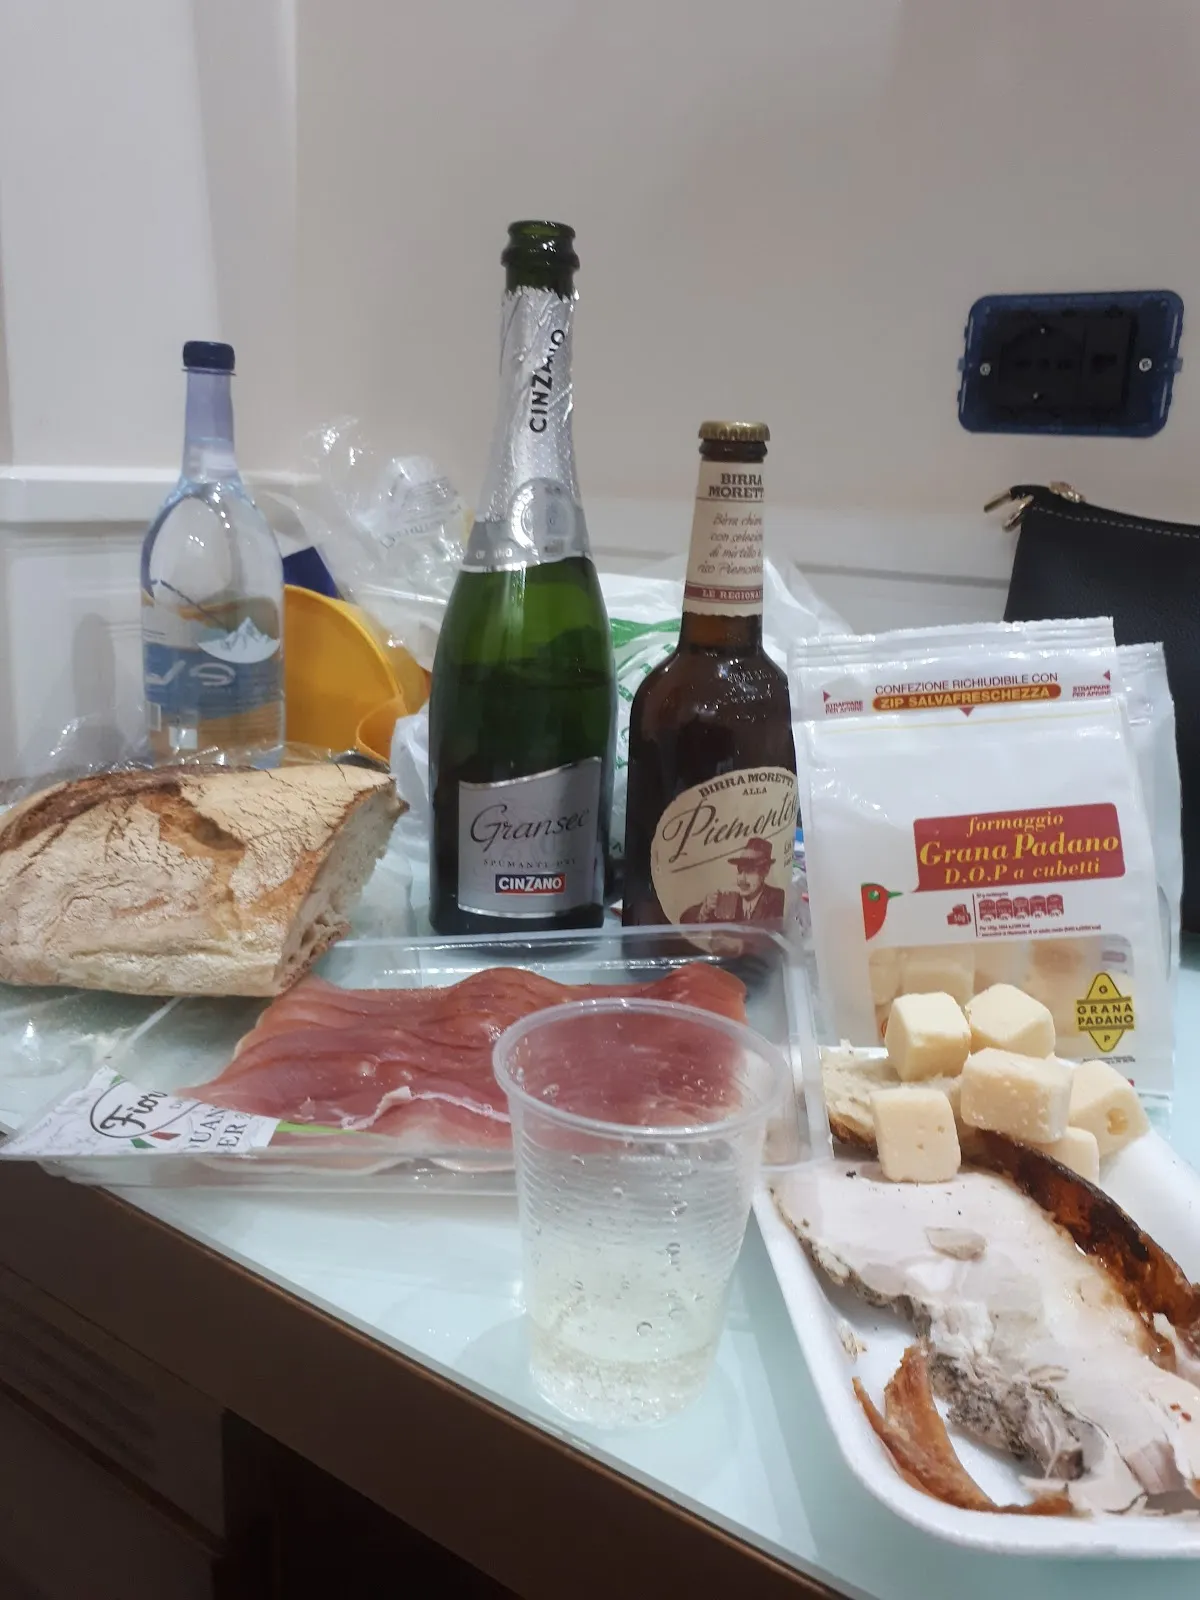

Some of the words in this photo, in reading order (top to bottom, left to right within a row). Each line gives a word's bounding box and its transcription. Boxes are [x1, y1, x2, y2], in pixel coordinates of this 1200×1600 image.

[720, 473, 763, 485] BIRRA
[708, 485, 764, 499] MORETT
[713, 512, 739, 526] Birra
[702, 588, 716, 598] LE
[719, 590, 761, 600] REGIONA
[875, 680, 949, 696] CONFEZIONE
[952, 674, 1029, 689] RICHIUDIBILE
[1031, 672, 1058, 683] CON
[880, 698, 905, 709] ZIP
[908, 686, 1050, 707] SALVAFRESCHEZZA
[698, 776, 746, 799] BIRRA
[742, 786, 768, 797] ALLA
[966, 811, 1064, 838] formaggio
[919, 840, 1009, 867] Grana
[1012, 831, 1119, 861] Padano
[944, 864, 1008, 885] D.O.P
[1013, 868, 1025, 880] a
[1032, 857, 1101, 878] cubetti
[498, 876, 562, 893] CINZANO
[1098, 985, 1108, 994] G
[1077, 1003, 1133, 1015] GRANA
[1078, 1014, 1134, 1026] PADANO
[1103, 1034, 1111, 1043] P
[217, 1123, 248, 1147] ER
